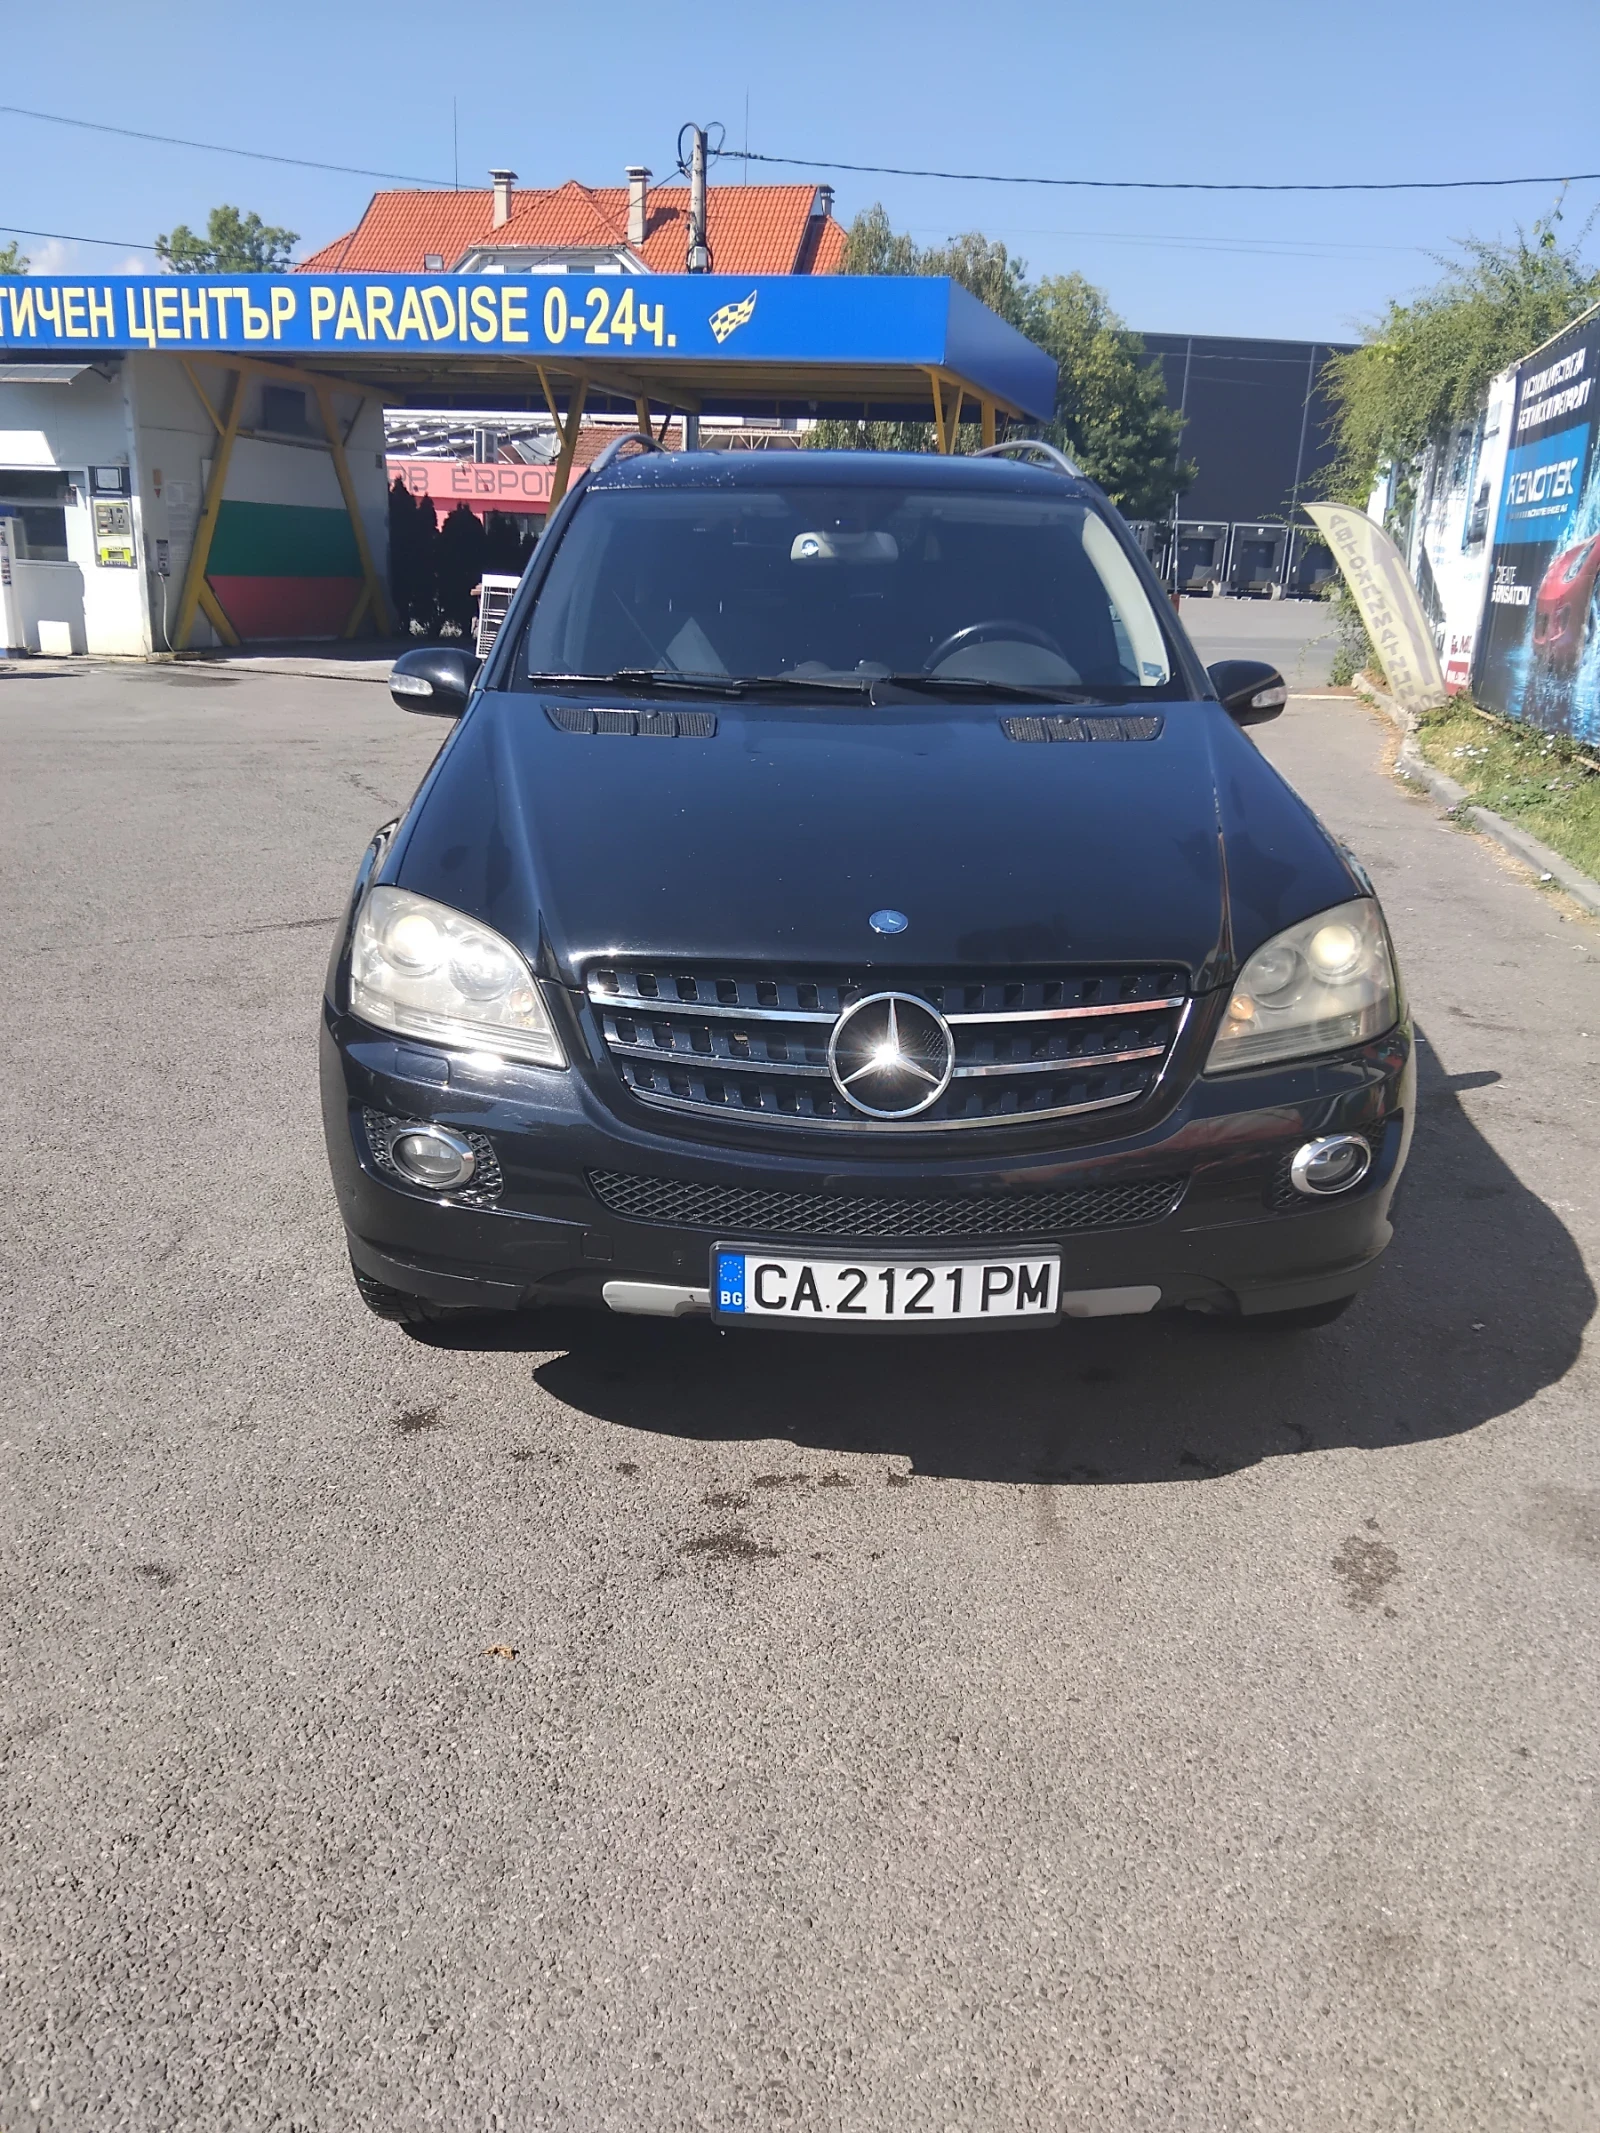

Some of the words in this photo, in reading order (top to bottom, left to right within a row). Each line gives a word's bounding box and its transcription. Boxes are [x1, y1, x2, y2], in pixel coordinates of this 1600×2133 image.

[126, 287, 296, 348] ЦЕНТЪР
[310, 285, 528, 343] PARADISE
[1506, 457, 1579, 505] KENOTEK
[720, 1290, 743, 1306] BG
